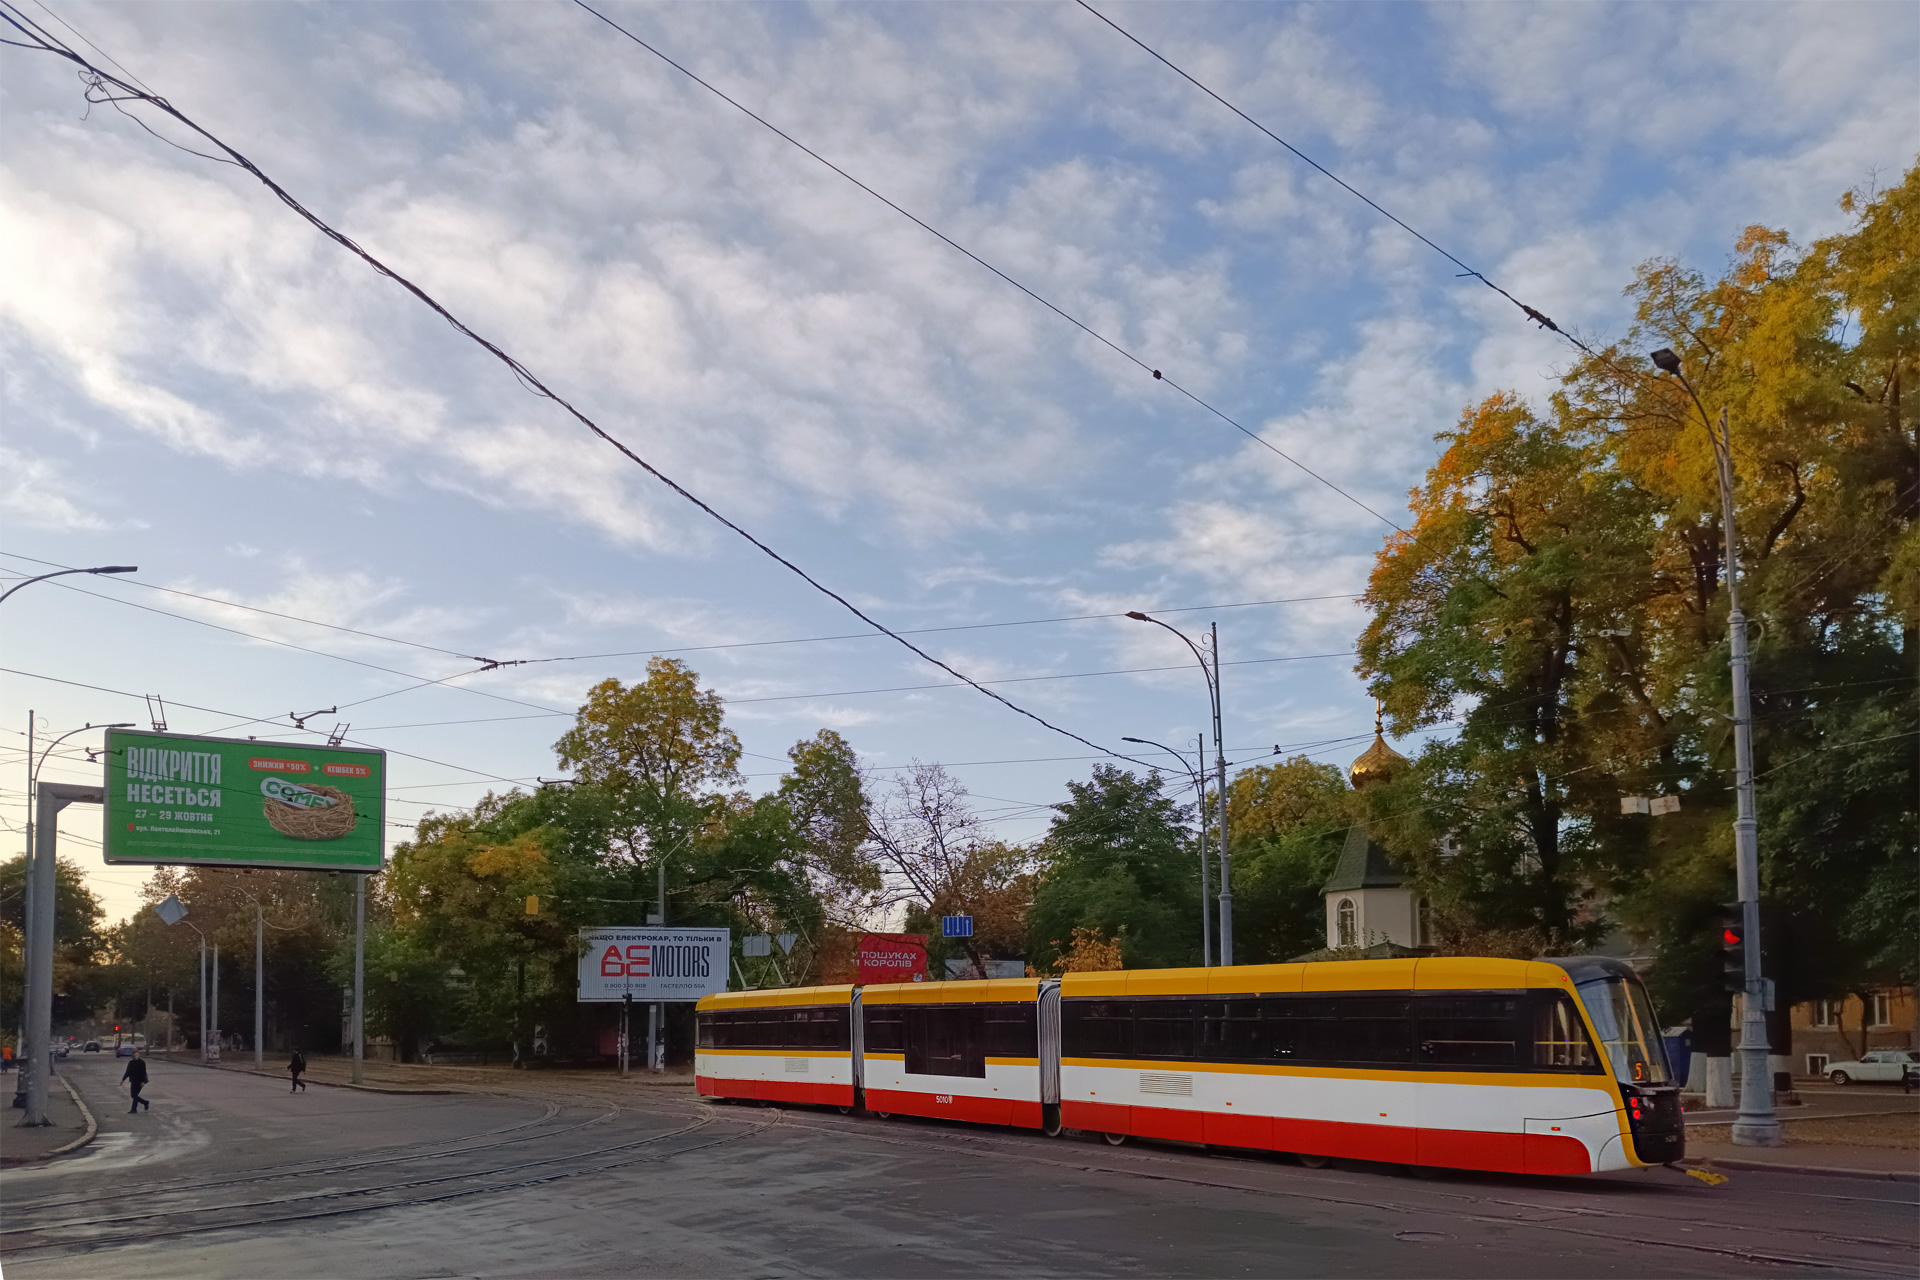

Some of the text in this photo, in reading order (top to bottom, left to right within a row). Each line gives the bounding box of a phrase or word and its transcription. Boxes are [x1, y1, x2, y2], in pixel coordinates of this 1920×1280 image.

[127, 746, 221, 785] ВІДКРИТТЯ
[253, 760, 284, 770] ЗНИЖКИ
[327, 765, 354, 774] КЕШБЕК
[355, 767, 366, 775] 5%
[127, 783, 221, 808] НЕСЕТЬСЯ
[135, 809, 147, 819] 27
[159, 811, 171, 820] 29
[174, 811, 213, 822] ЖОВТНЯ
[616, 934, 671, 943] ЕЛЕКТРОКАР,
[651, 945, 710, 977] MOTORS
[861, 951, 917, 960] ПОШУКАХ
[864, 959, 912, 968] КОРОЛІВ
[1635, 1062, 1642, 1080] 5
